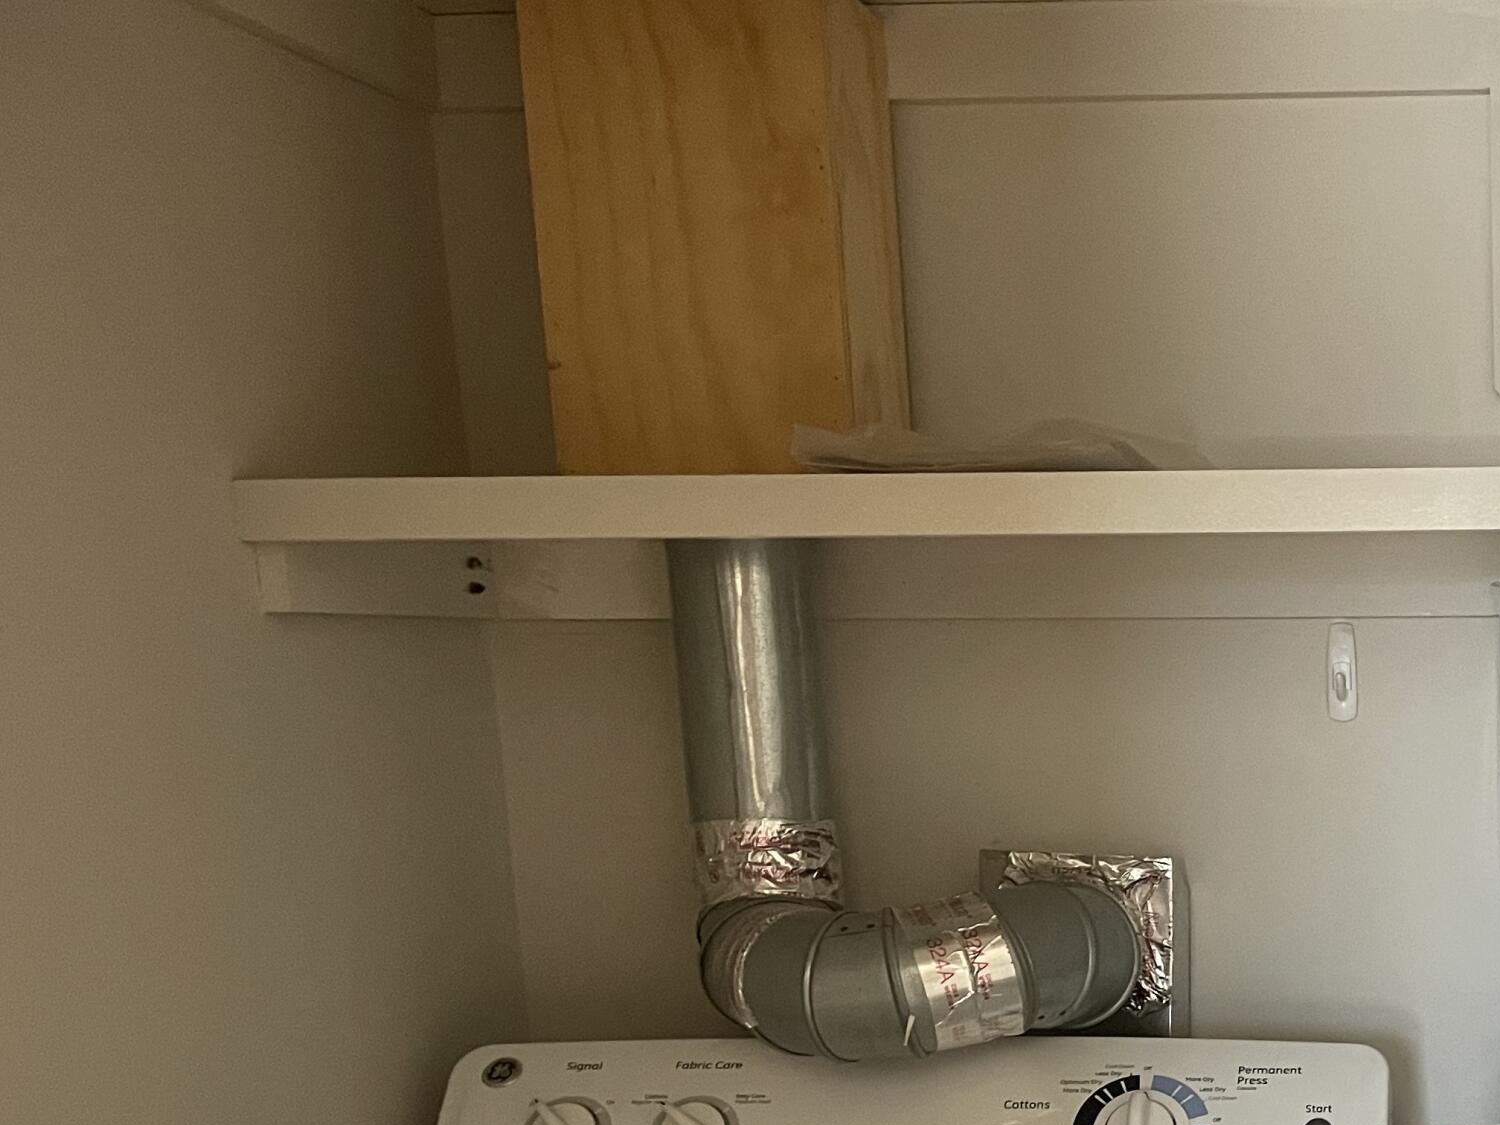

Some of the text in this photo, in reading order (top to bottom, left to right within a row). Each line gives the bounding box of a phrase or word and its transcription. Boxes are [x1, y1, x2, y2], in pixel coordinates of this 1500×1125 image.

[567, 1062, 603, 1072] Signal
[676, 1061, 744, 1070] Fabric Care
[1238, 1065, 1302, 1075] Permanent
[1237, 1076, 1268, 1085] Press
[1004, 1100, 1050, 1109] Cottons
[1305, 1104, 1332, 1113] Start
